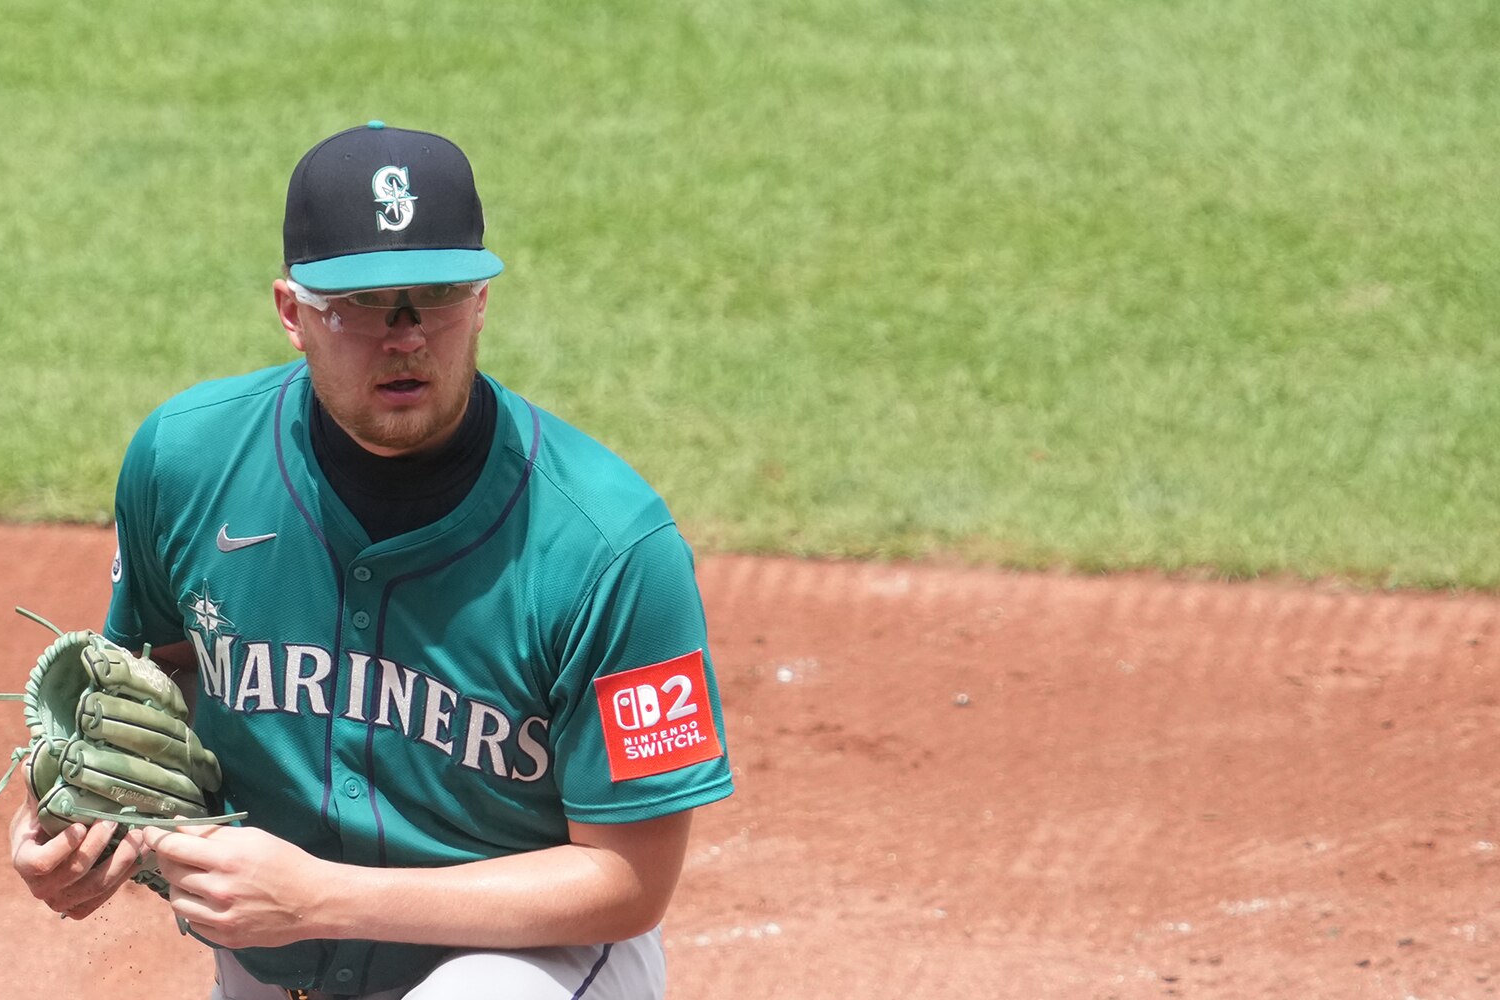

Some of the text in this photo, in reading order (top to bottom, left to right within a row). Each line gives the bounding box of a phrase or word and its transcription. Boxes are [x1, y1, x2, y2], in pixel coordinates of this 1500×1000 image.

[371, 165, 418, 232] S
[187, 627, 551, 783] MARINERS
[660, 674, 698, 722] 2
[624, 720, 698, 746] NINTENDO
[625, 729, 701, 760] SWITCH
